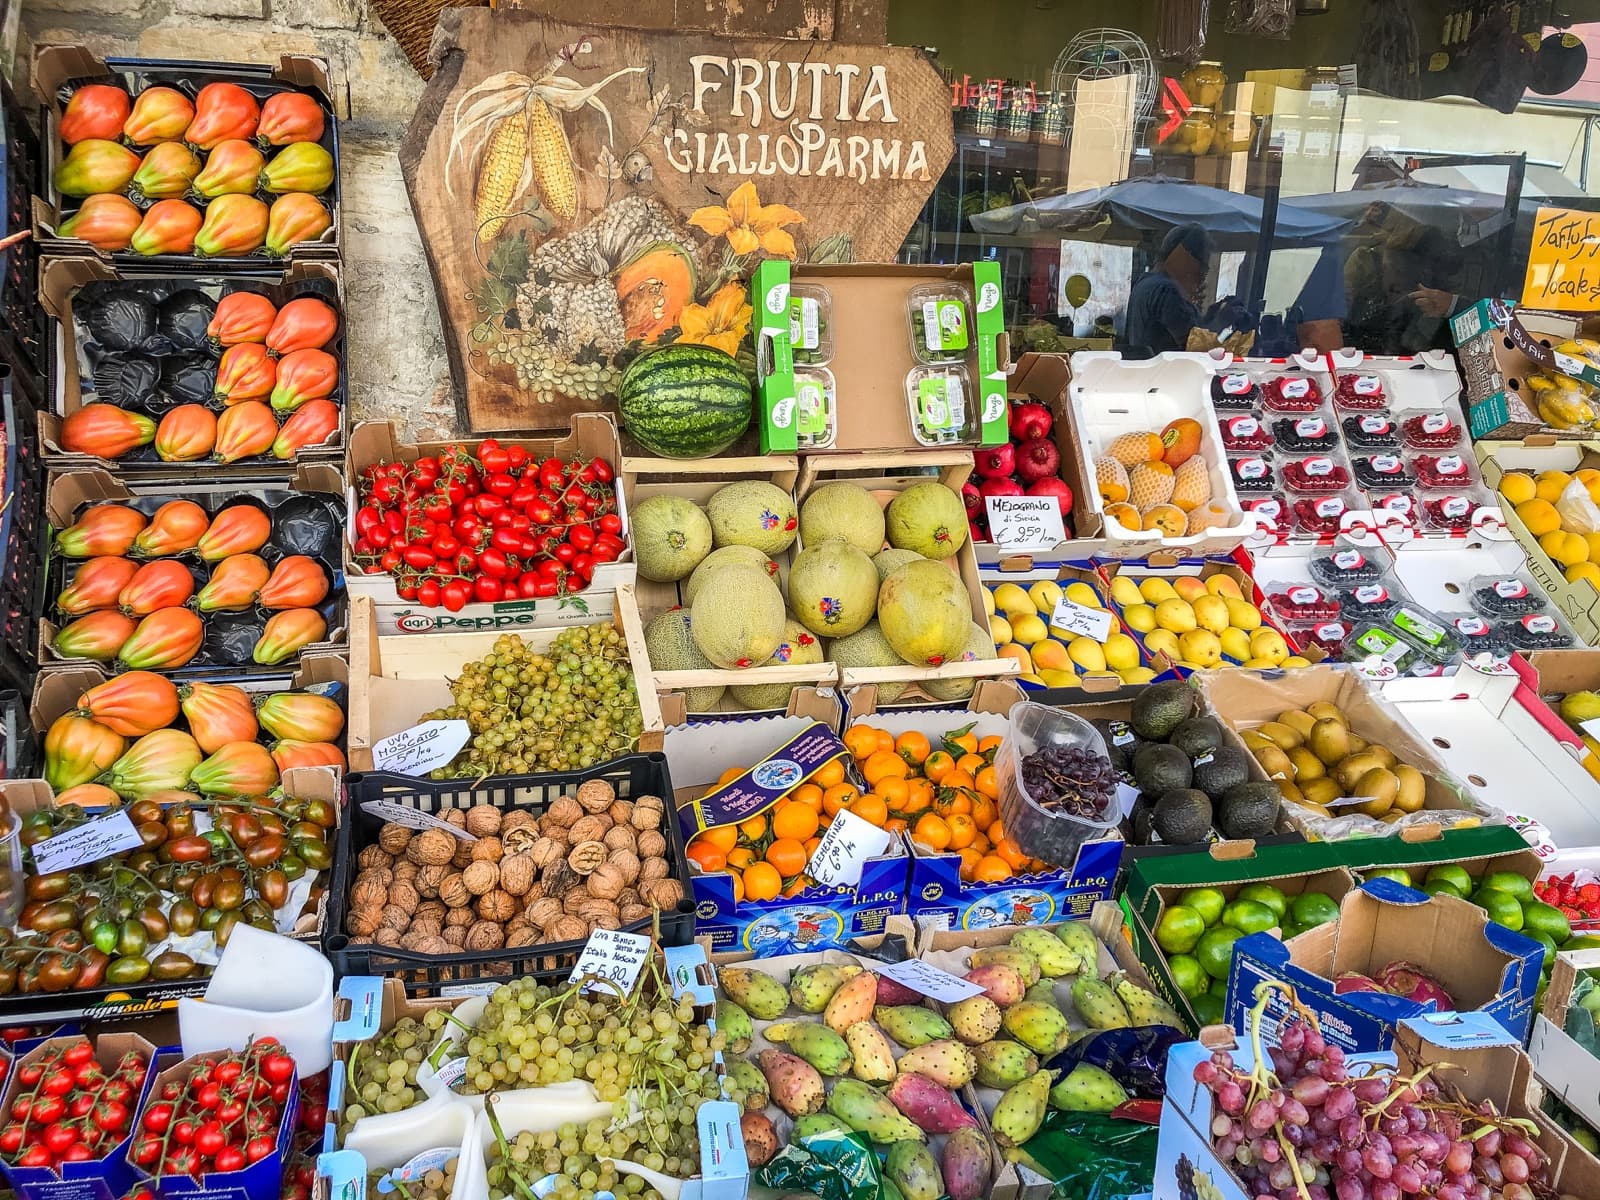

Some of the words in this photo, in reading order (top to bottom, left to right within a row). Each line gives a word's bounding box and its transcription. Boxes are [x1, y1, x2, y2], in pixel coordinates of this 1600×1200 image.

[689, 56, 898, 127] FRUTTA
[1512, 327, 1528, 349] By
[1528, 345, 1547, 365] Air
[992, 498, 1050, 511] MELOGRANO
[436, 614, 536, 629] Peppe
[377, 727, 438, 757] MOSCATO
[386, 732, 408, 746] UVA
[580, 960, 594, 973] €
[82, 1001, 163, 1018] agrisole
